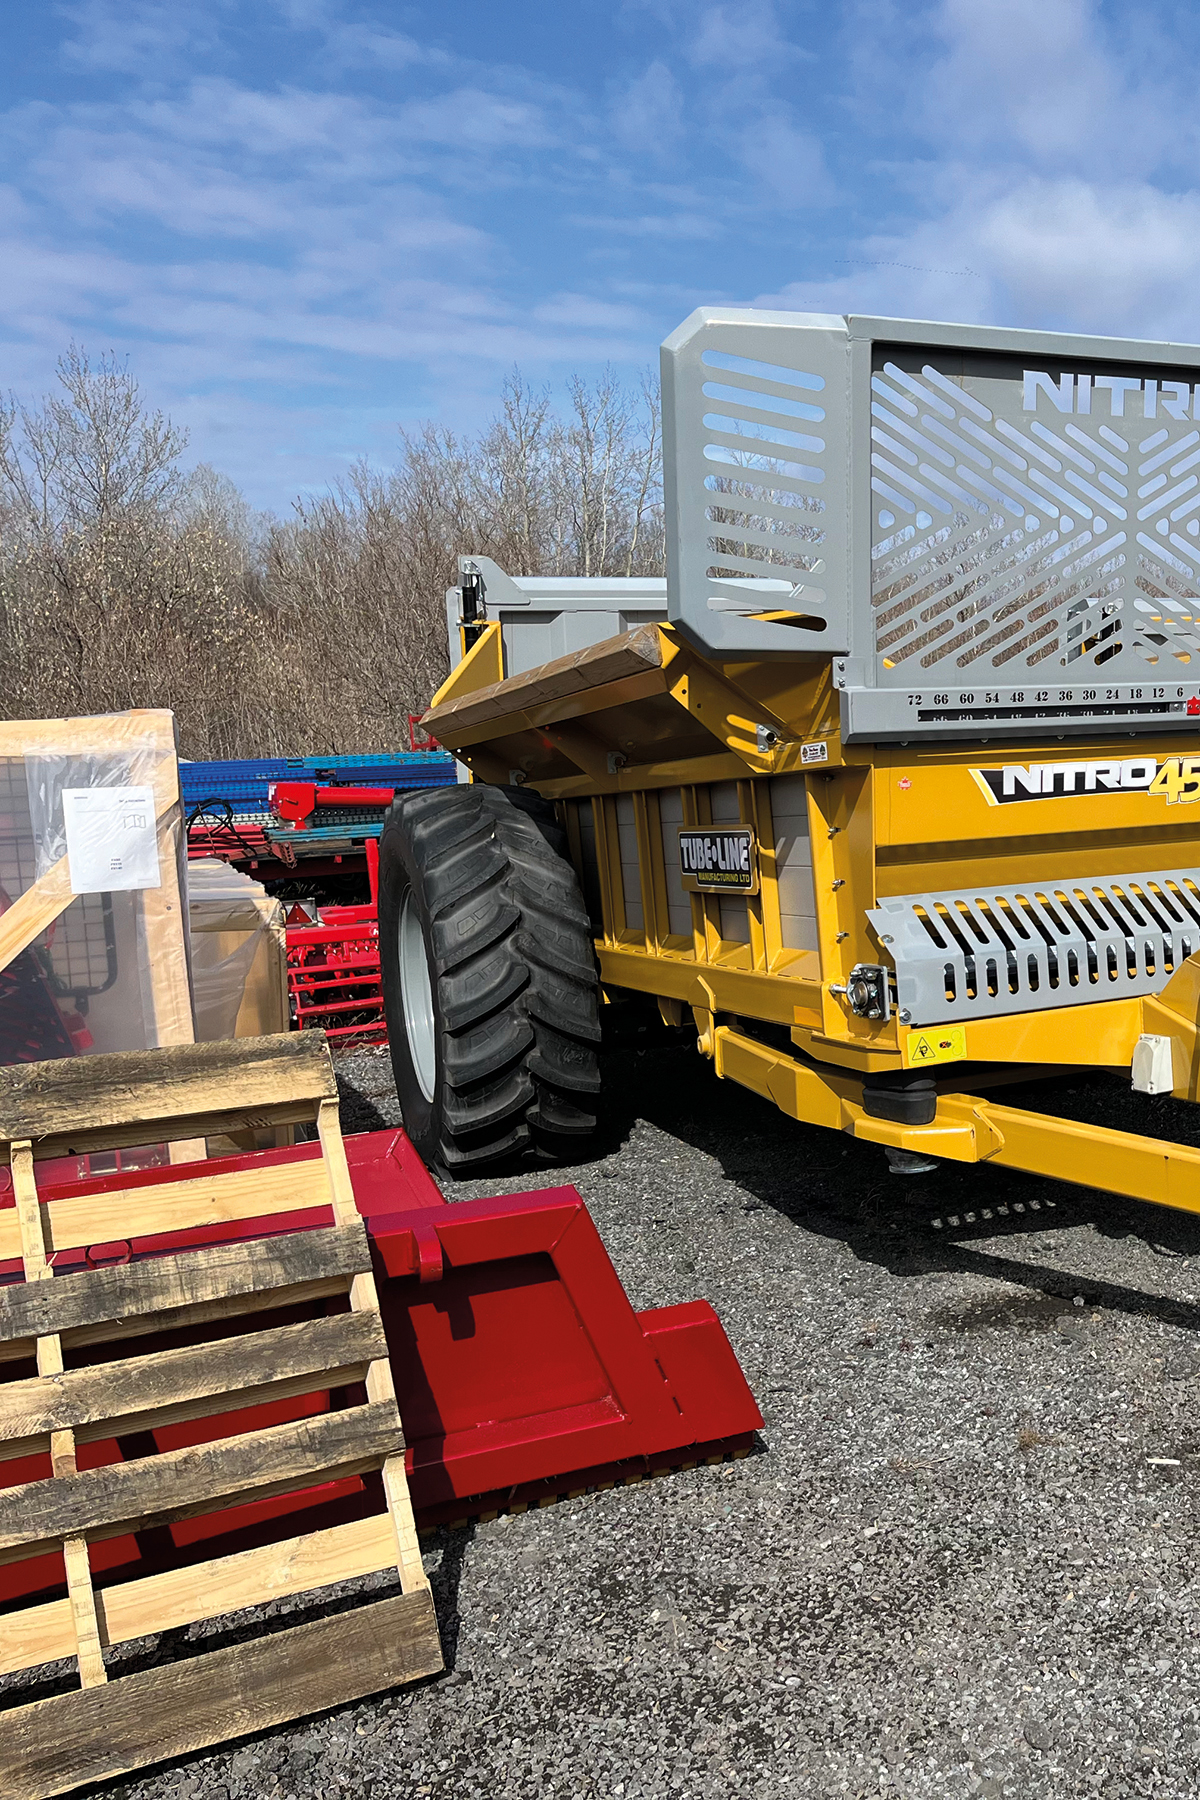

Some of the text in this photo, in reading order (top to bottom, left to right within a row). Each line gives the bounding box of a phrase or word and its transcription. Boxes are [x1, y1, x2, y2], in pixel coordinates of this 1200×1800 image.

[908, 694, 923, 705] 72
[934, 693, 949, 704] 66
[960, 693, 975, 704] 60
[985, 692, 1000, 703] 54
[1010, 691, 1025, 702] 48
[1034, 690, 1049, 702] 42
[1059, 690, 1073, 701] 36
[1082, 689, 1097, 700] 30
[1106, 689, 1120, 700] 24
[1130, 688, 1143, 699] 18
[1152, 687, 1165, 698] 12
[1176, 687, 1184, 697] 6
[698, 872, 750, 883] MANUFACTURING LTD
